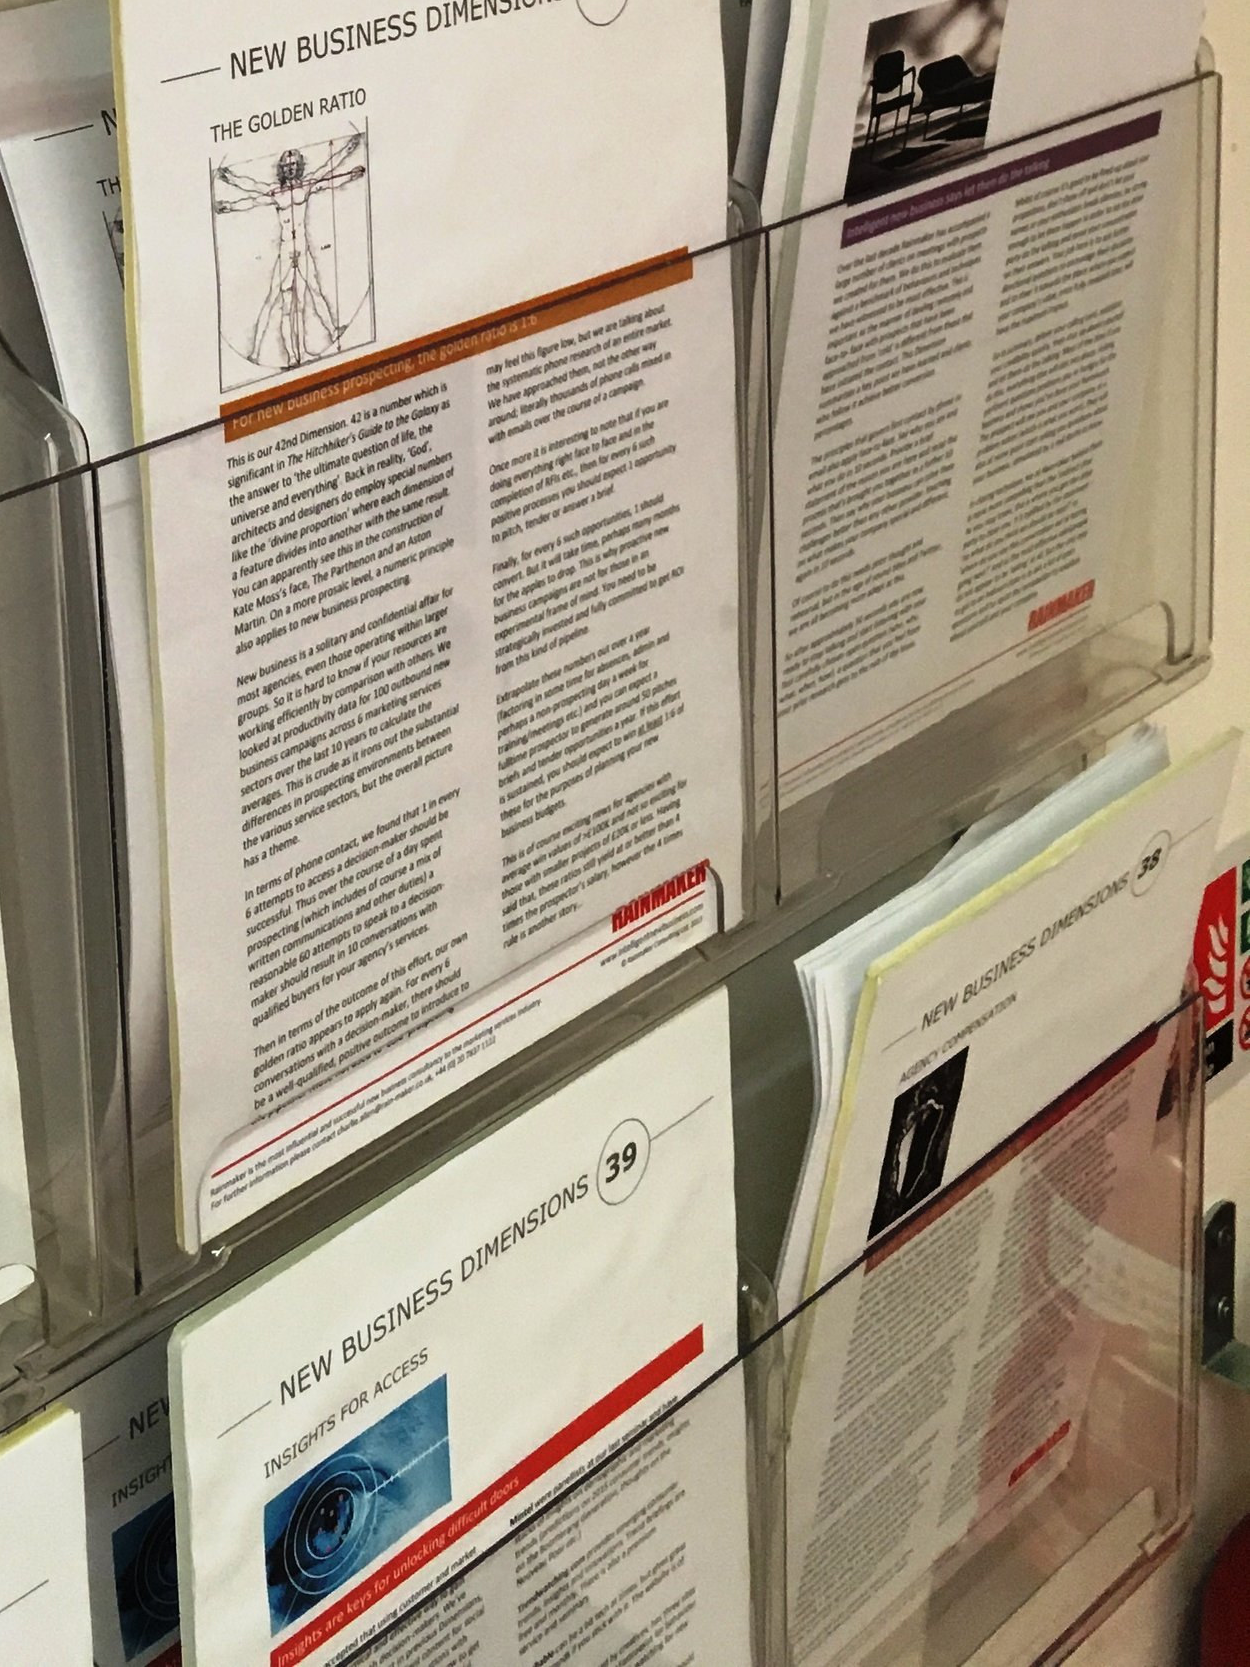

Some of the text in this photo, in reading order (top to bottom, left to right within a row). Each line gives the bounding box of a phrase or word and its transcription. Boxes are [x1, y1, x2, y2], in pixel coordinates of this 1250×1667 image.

[230, 40, 286, 79] NEW
[297, 10, 416, 63] BUSINESS
[209, 87, 366, 142] THE GOLDEN RATIO
[96, 176, 121, 196] TH
[226, 455, 245, 469] This
[247, 452, 255, 461] is
[256, 445, 272, 458] our
[274, 434, 297, 451] 42nd
[350, 411, 361, 424] 42
[363, 410, 370, 419] is
[372, 408, 377, 417] a
[379, 395, 412, 414] number
[413, 384, 438, 401] which
[440, 382, 447, 391] is
[921, 847, 1162, 1031] NEW BUSINESS DIMENSIONS 38
[280, 1141, 637, 1406] NEW BUSINESS DIMENSIONS 39
[263, 1347, 429, 1479] INSIGHTS FOR ACCESS
[278, 1477, 519, 1667] Insights are keys for unlocking difficult doors
